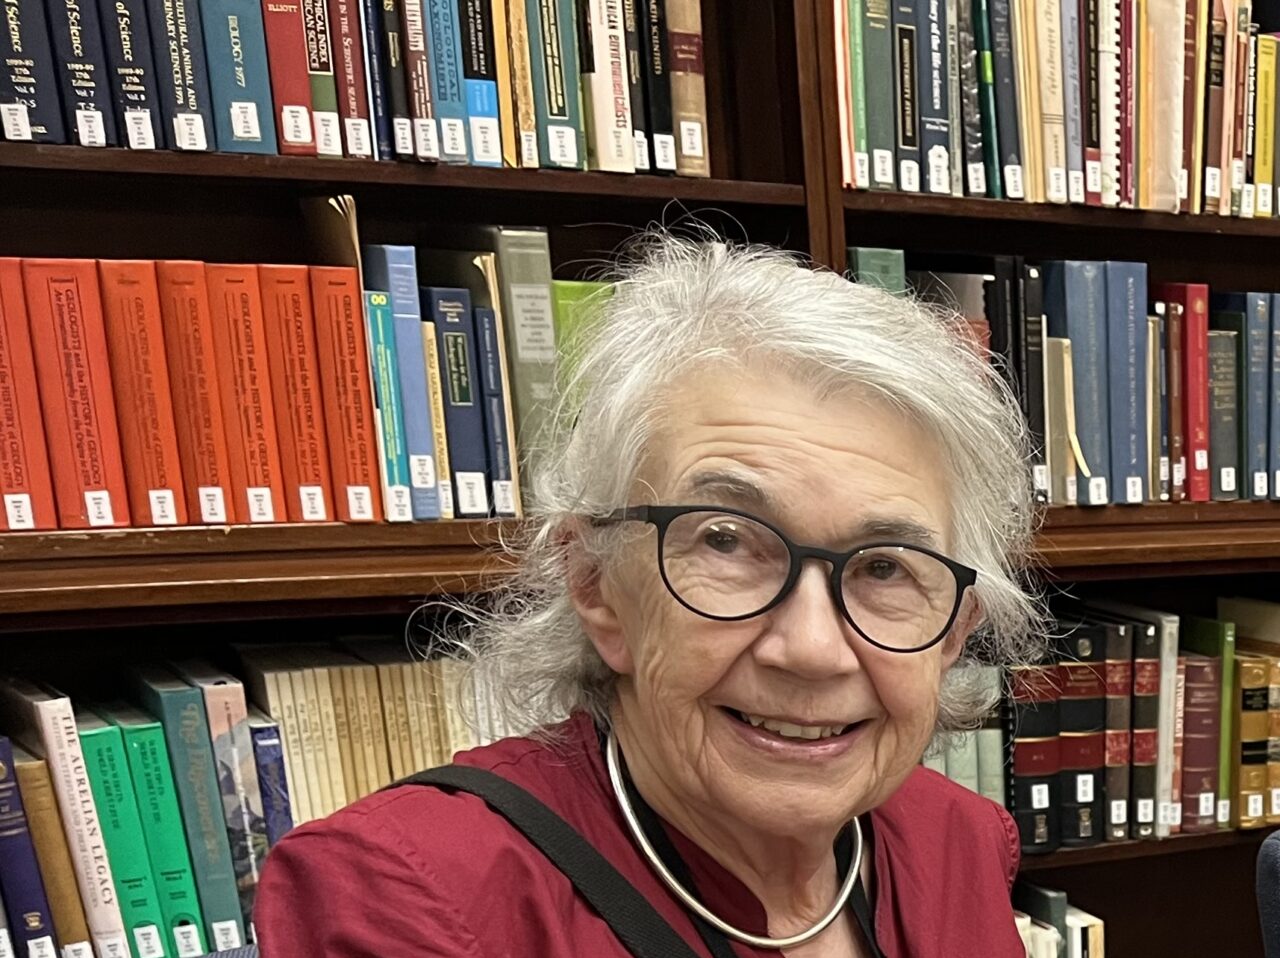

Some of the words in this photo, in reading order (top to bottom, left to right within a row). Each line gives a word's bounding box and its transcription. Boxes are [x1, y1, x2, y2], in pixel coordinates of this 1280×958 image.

[5, 4, 22, 53] Science
[115, 2, 129, 15] of
[268, 4, 297, 13] ELLIOTT
[67, 12, 83, 57] Science
[118, 14, 133, 62] Science
[228, 16, 243, 65] BIOLOGY
[307, 31, 319, 69] SCIENCE
[318, 33, 328, 63] INDEX
[651, 25, 662, 74] SCIENTISTS
[167, 39, 184, 85] SCIENCES
[180, 46, 195, 85] ANIMAL
[609, 34, 627, 128] environmentalists
[932, 52, 942, 68] life
[186, 87, 198, 110] AND
[932, 69, 943, 110] sciences
[64, 288, 81, 350] GEOLOGISTS
[78, 385, 94, 428] HISTORY
[1, 386, 15, 428] HISTORY
[62, 715, 78, 751] THE
[71, 754, 98, 836] AURELIAN
[92, 844, 114, 907] LEGACY
